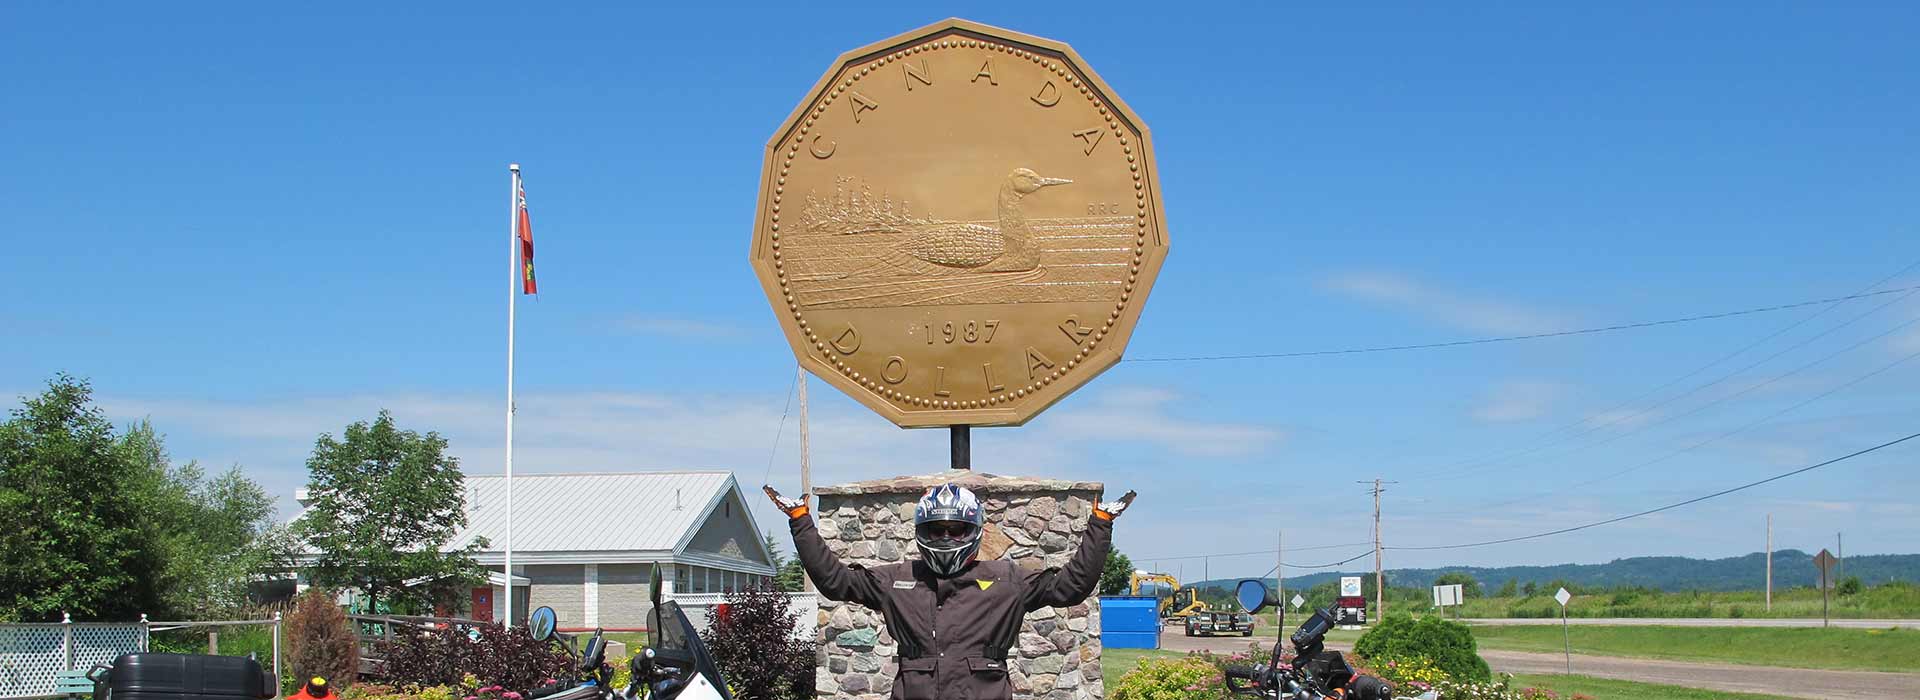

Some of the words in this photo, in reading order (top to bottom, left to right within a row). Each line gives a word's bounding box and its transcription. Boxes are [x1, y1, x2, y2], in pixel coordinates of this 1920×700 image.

[809, 57, 1105, 159] CANADA
[1088, 202, 1119, 216] RRC
[829, 314, 1093, 398] DOLLAR
[924, 319, 1000, 345] 1987
